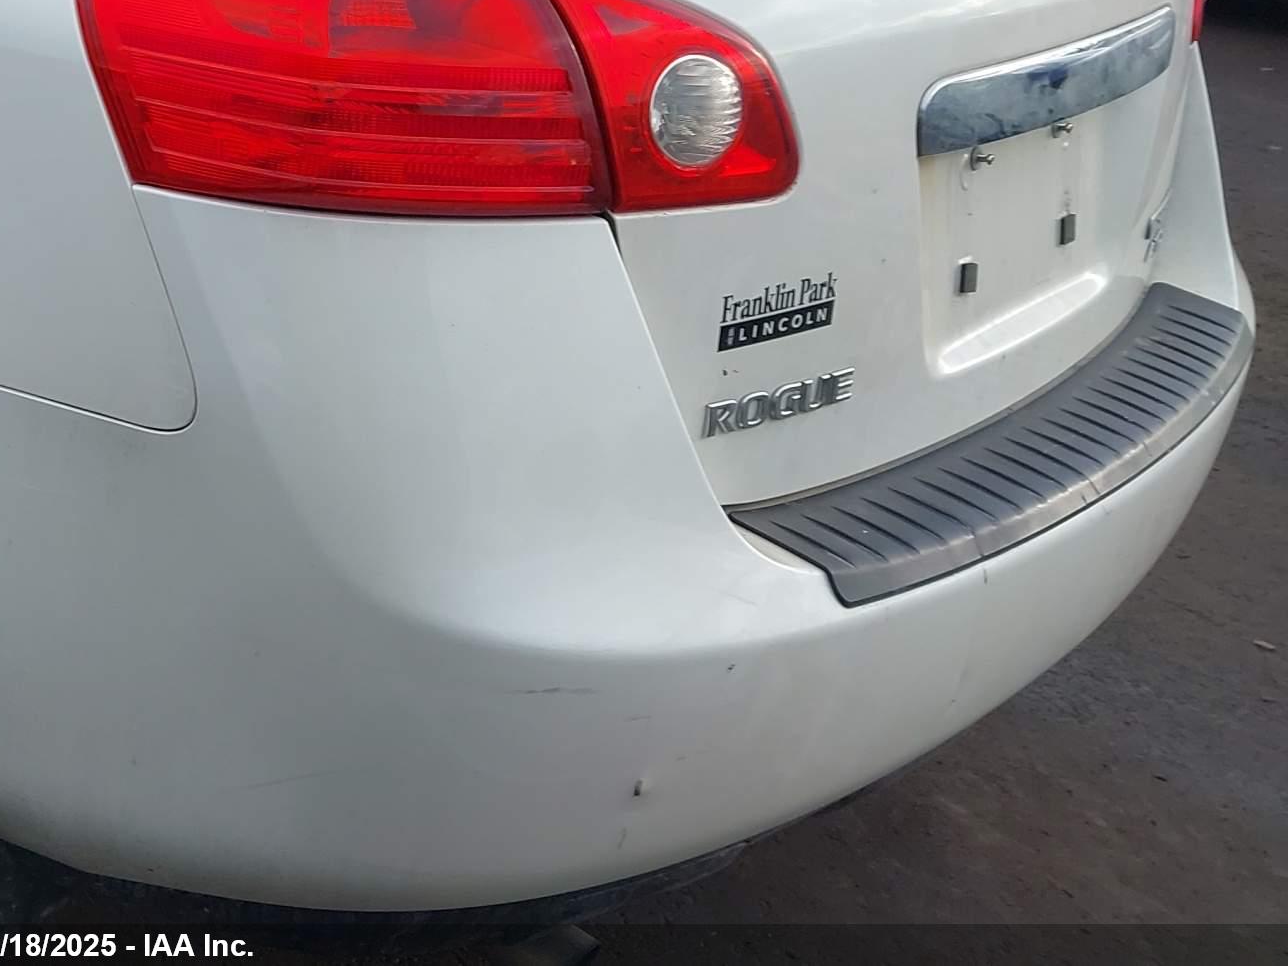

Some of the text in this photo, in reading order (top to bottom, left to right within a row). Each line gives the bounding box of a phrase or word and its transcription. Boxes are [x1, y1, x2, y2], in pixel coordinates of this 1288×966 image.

[722, 272, 837, 323] Franklin Park
[738, 308, 827, 341] LINCOLN
[702, 367, 855, 438] ROGUE
